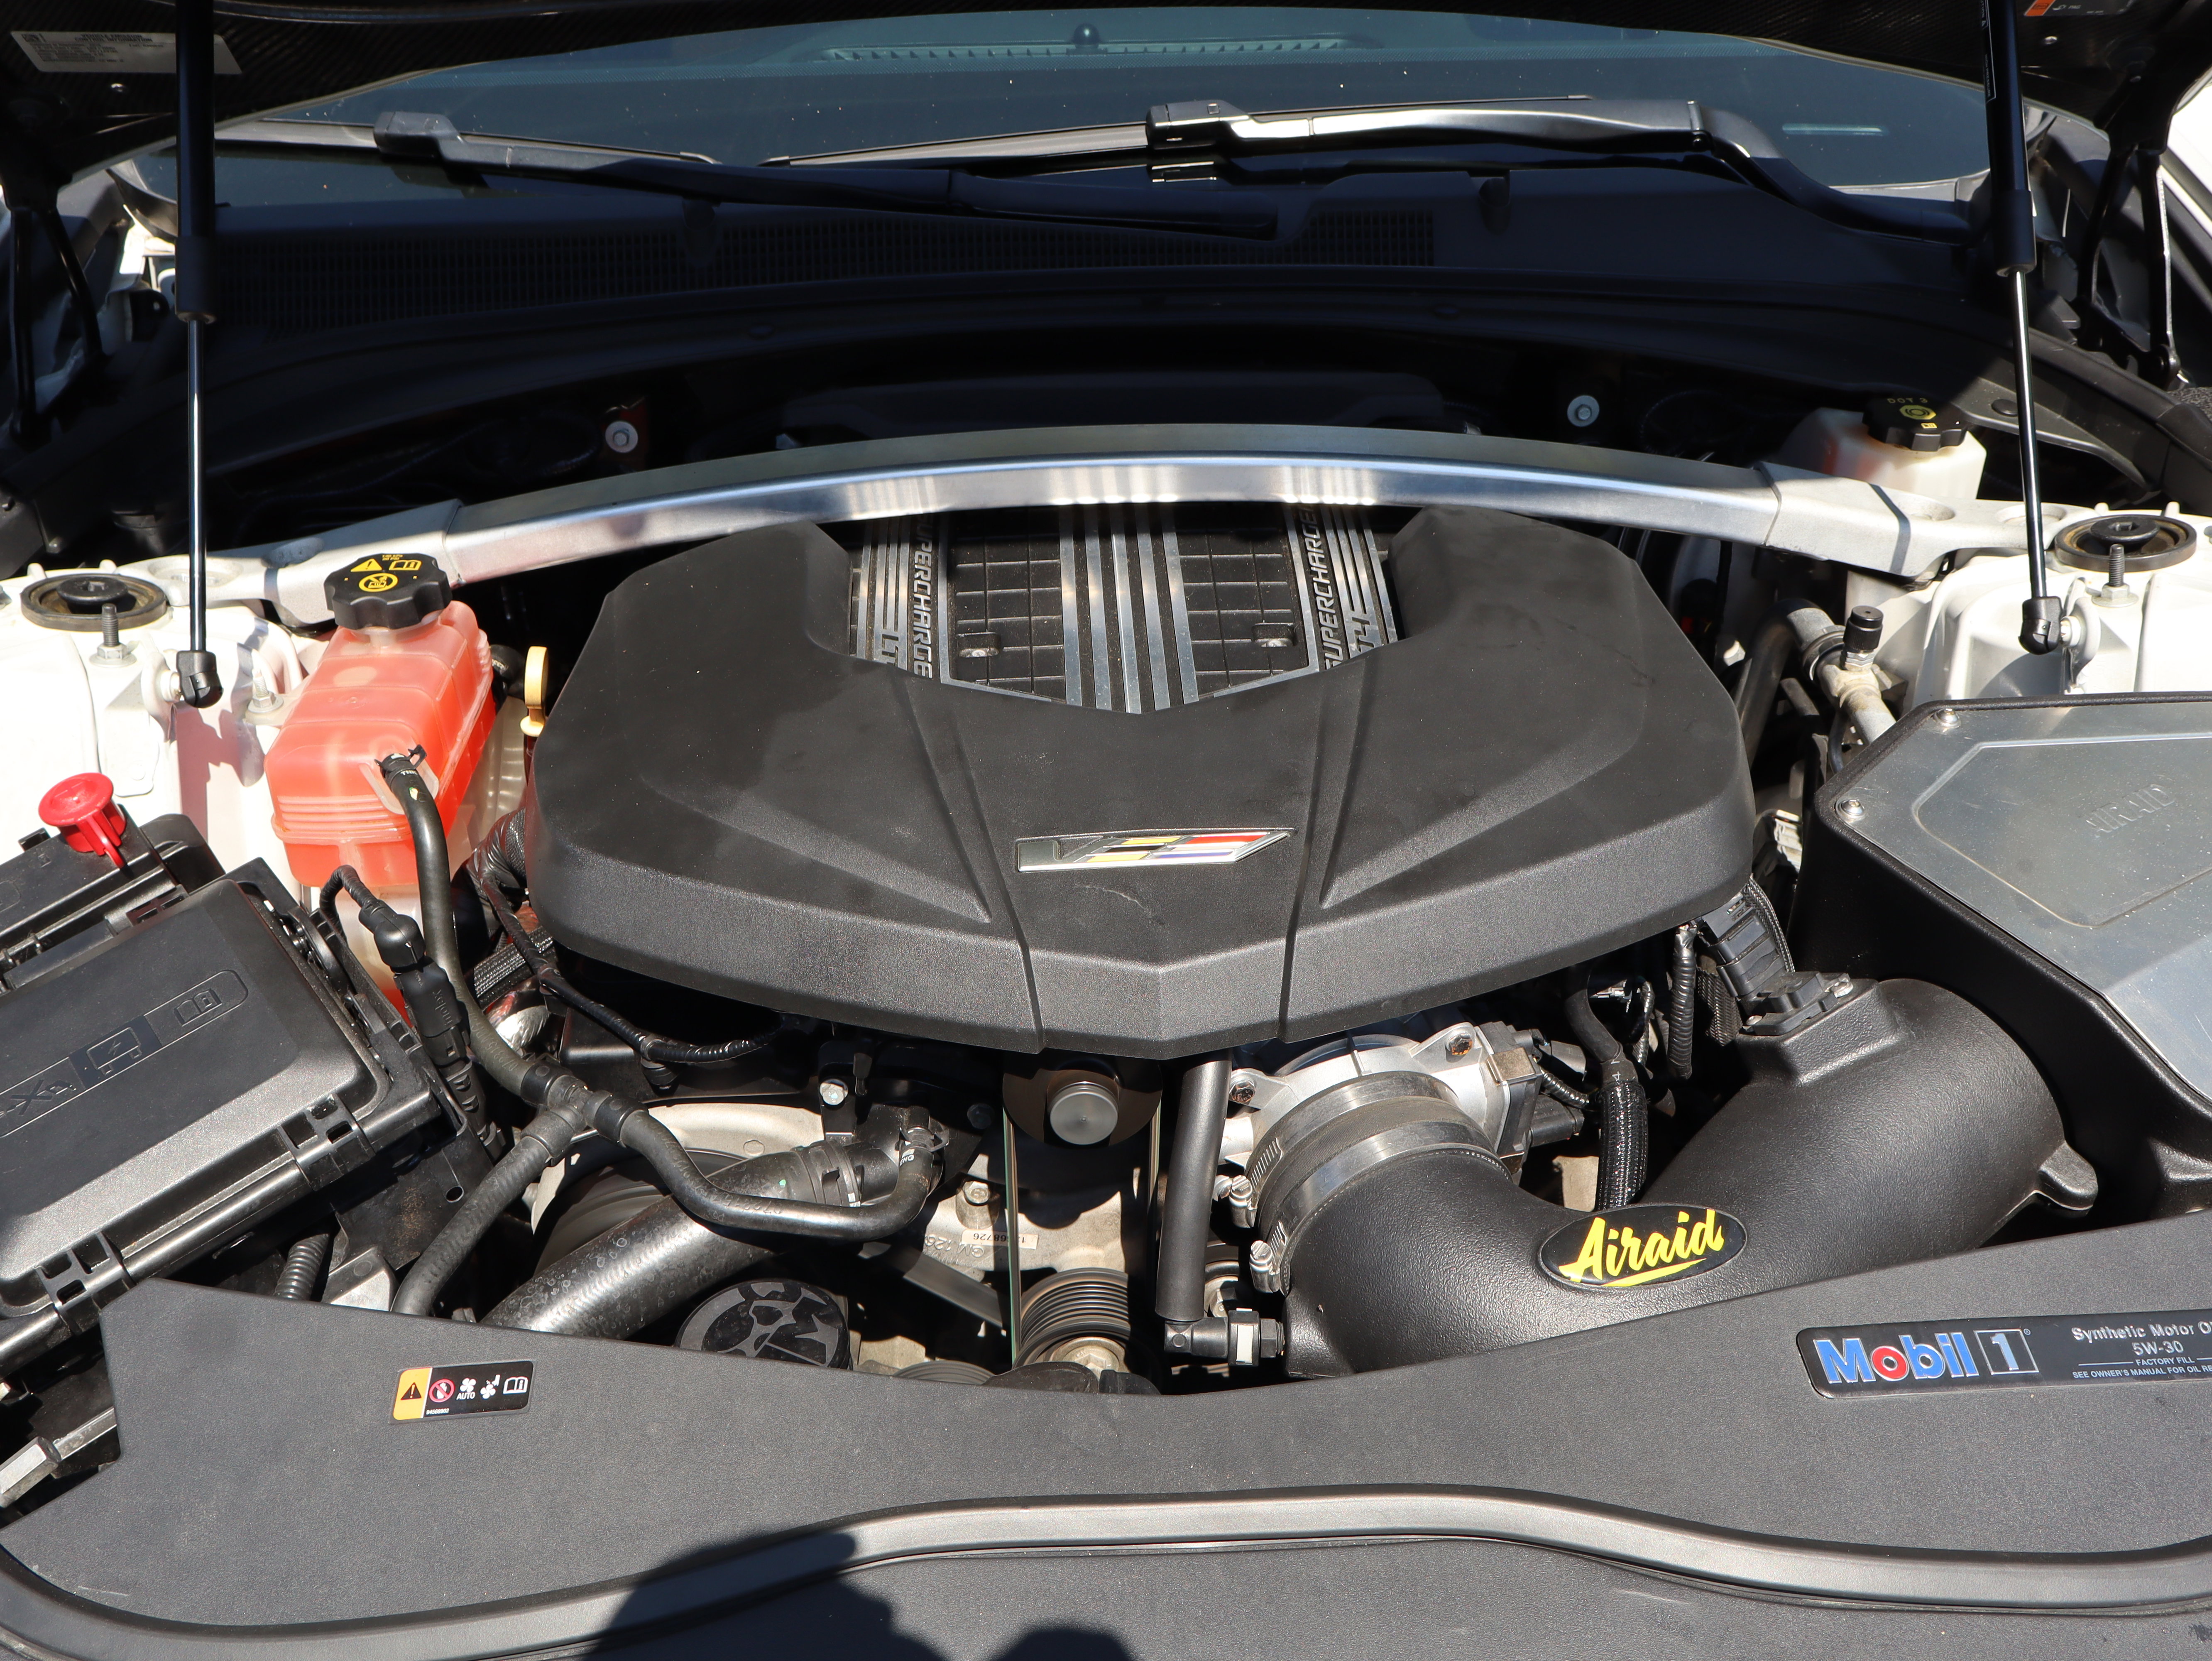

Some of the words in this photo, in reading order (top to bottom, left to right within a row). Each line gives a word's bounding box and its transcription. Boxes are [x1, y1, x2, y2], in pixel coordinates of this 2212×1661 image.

[432, 988, 455, 1027] molex
[956, 1242, 985, 1258] GM
[1558, 1208, 1724, 1283] Airaid
[2071, 1325, 2146, 1343] Synthetic
[2148, 1323, 2195, 1337] Motor
[2131, 1340, 2184, 1356] 5W-30
[1813, 1332, 1980, 1384] Mobil
[1989, 1332, 2022, 1371] 1
[2135, 1358, 2175, 1366] FACTORY
[2091, 1369, 2130, 1378] OWNER'S
[2130, 1367, 2167, 1376] MANUAL
[2187, 1365, 2202, 1373] OIL
[456, 1391, 476, 1401] AUTO
